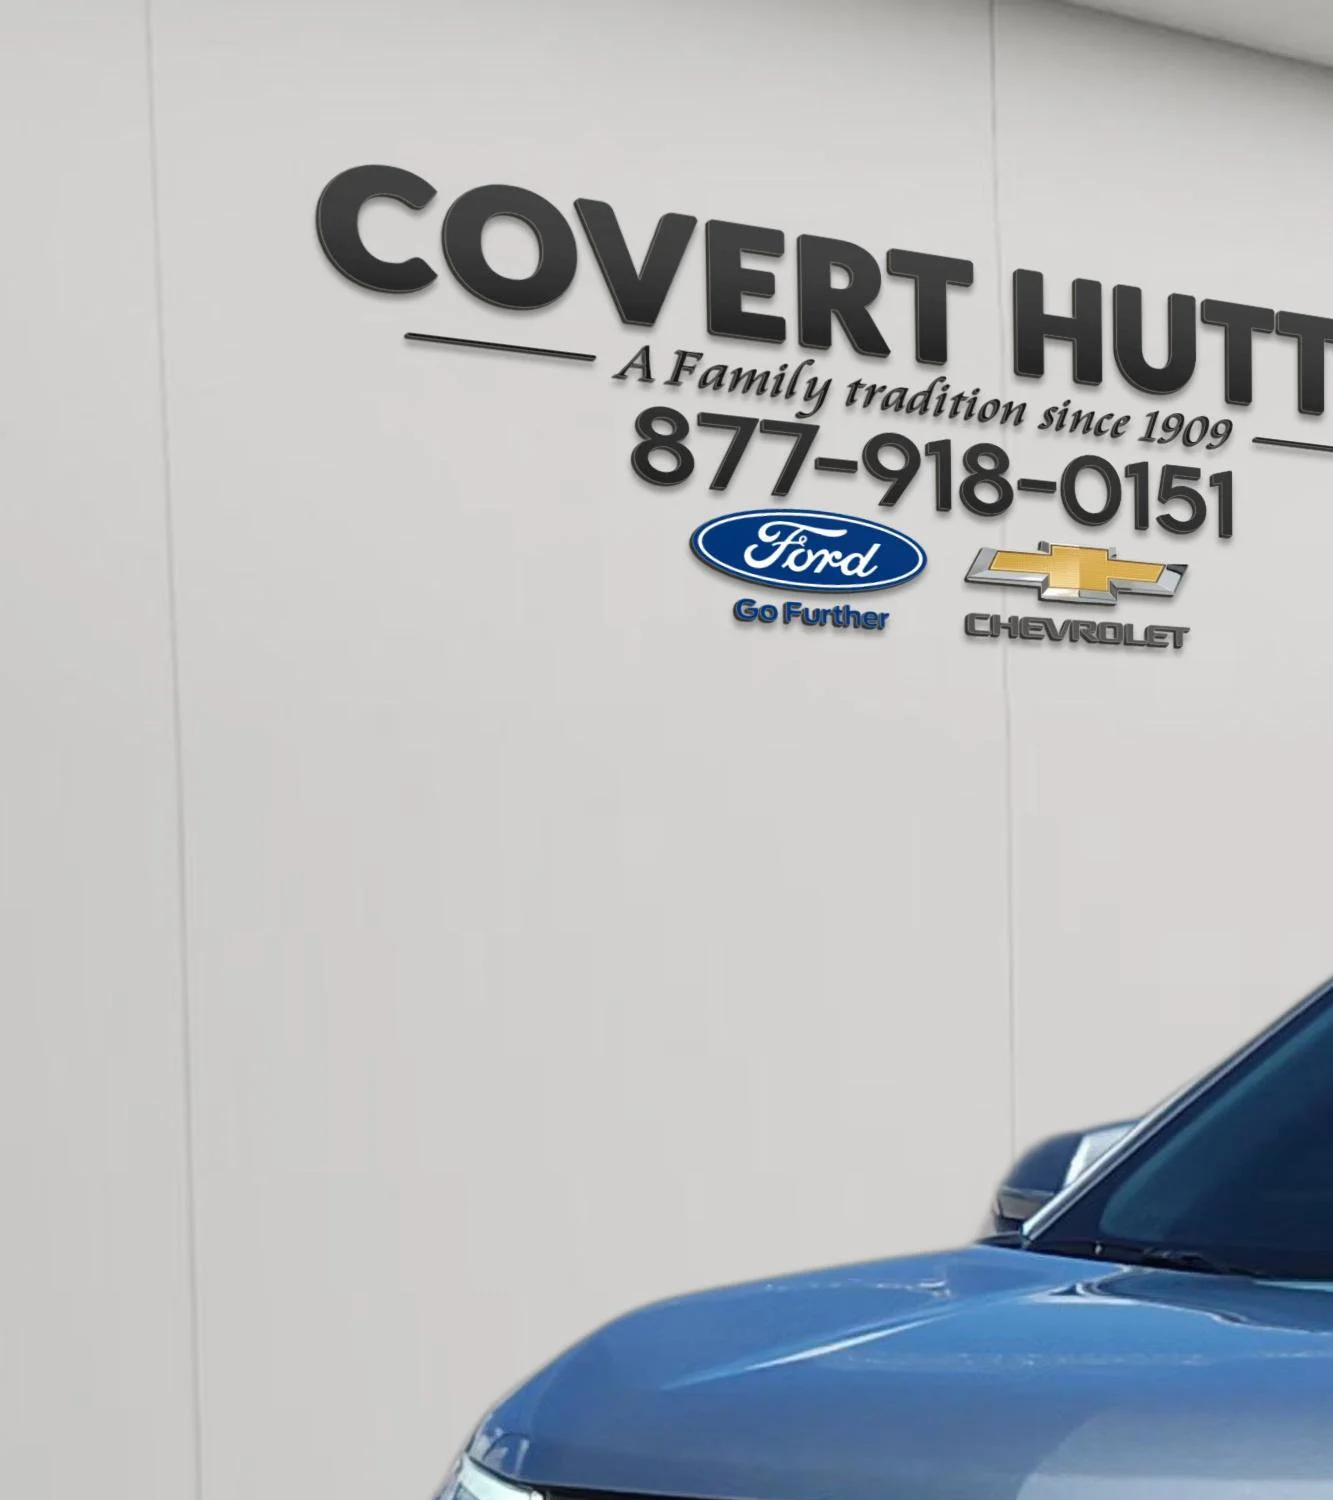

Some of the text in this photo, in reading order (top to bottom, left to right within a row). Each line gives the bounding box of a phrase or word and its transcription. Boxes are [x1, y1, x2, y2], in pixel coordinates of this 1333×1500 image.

[316, 165, 974, 365] COVERT
[612, 345, 1233, 450] A Family tradition since 1909
[631, 406, 1232, 538] 877-918-0151
[743, 520, 880, 578] Ford
[733, 599, 889, 630] Go Further
[964, 612, 1190, 649] CHEVROLET
